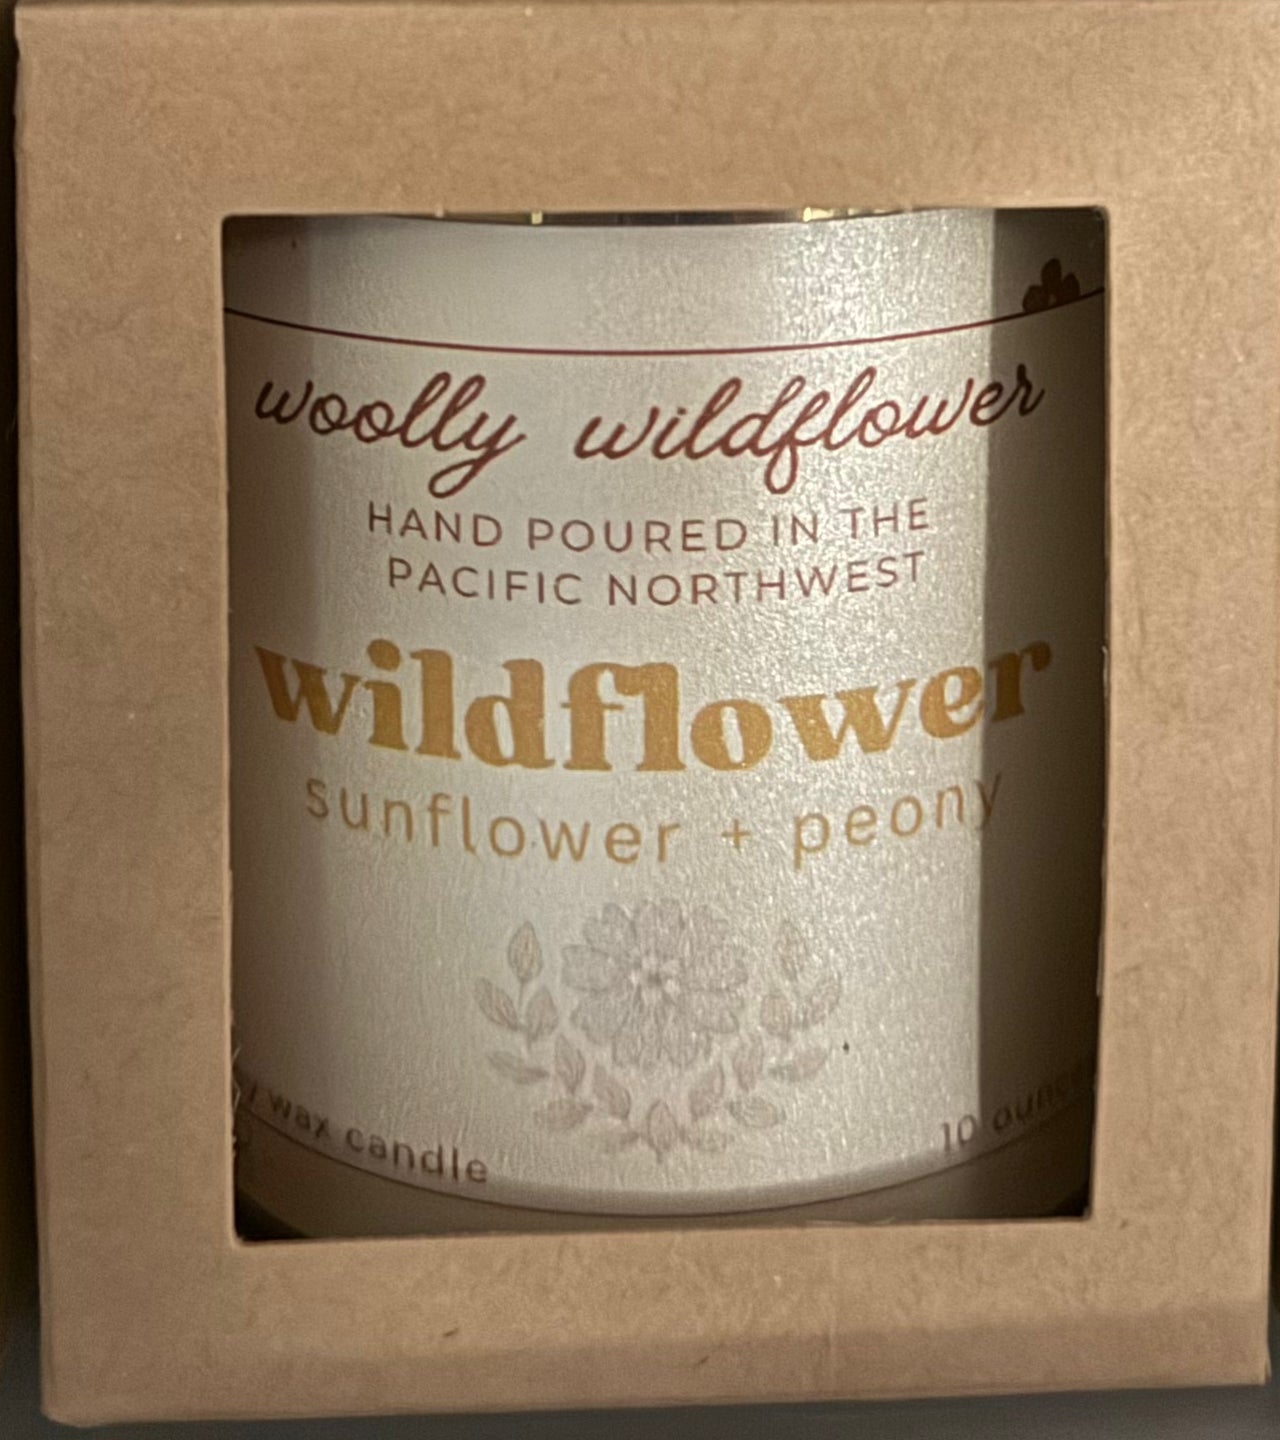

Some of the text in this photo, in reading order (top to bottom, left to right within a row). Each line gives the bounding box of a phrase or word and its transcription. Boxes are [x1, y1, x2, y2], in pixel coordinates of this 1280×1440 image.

[256, 364, 1047, 498] woolly wildflower
[367, 496, 930, 554] HAND POURED IN THE
[388, 551, 927, 607] PACIFIC NORTHWEST
[252, 637, 1055, 773] wildflower
[304, 772, 1005, 867] sunflower + peony
[271, 1093, 489, 1185] wax candle
